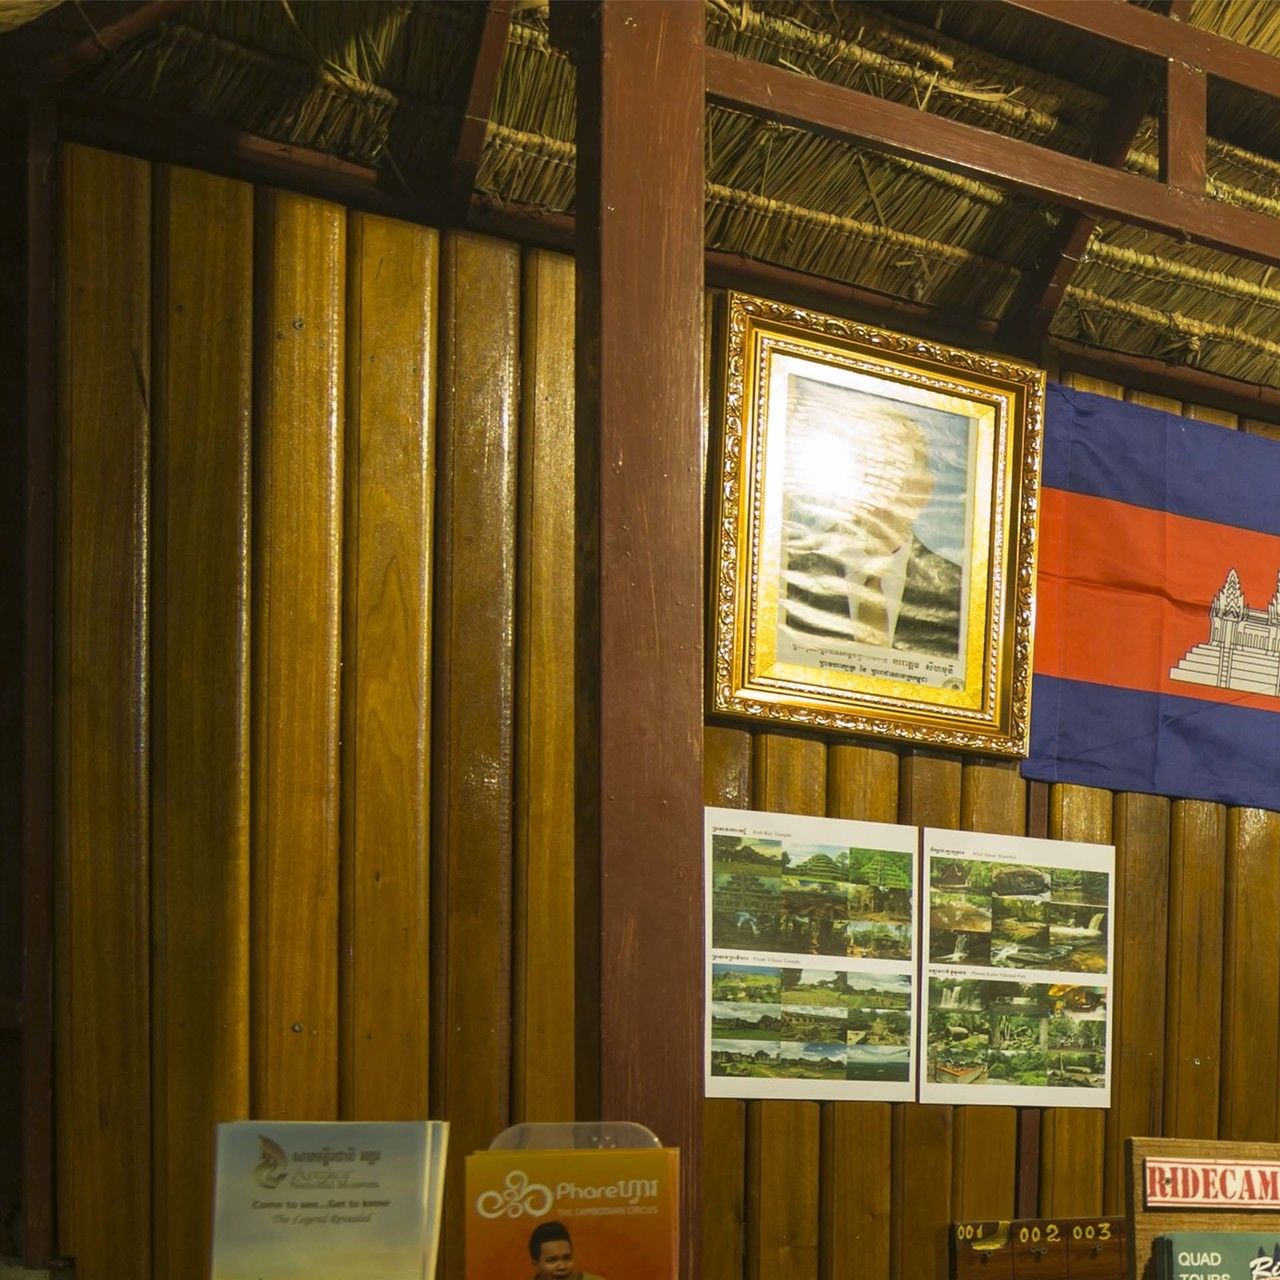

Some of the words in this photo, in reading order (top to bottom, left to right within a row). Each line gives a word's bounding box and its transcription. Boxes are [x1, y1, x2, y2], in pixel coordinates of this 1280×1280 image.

[557, 1182, 618, 1200] Phare
[362, 1200, 391, 1208] know
[1019, 1224, 1061, 1243] 002
[1072, 1223, 1111, 1241] 003
[1178, 1252, 1222, 1267] QUAD
